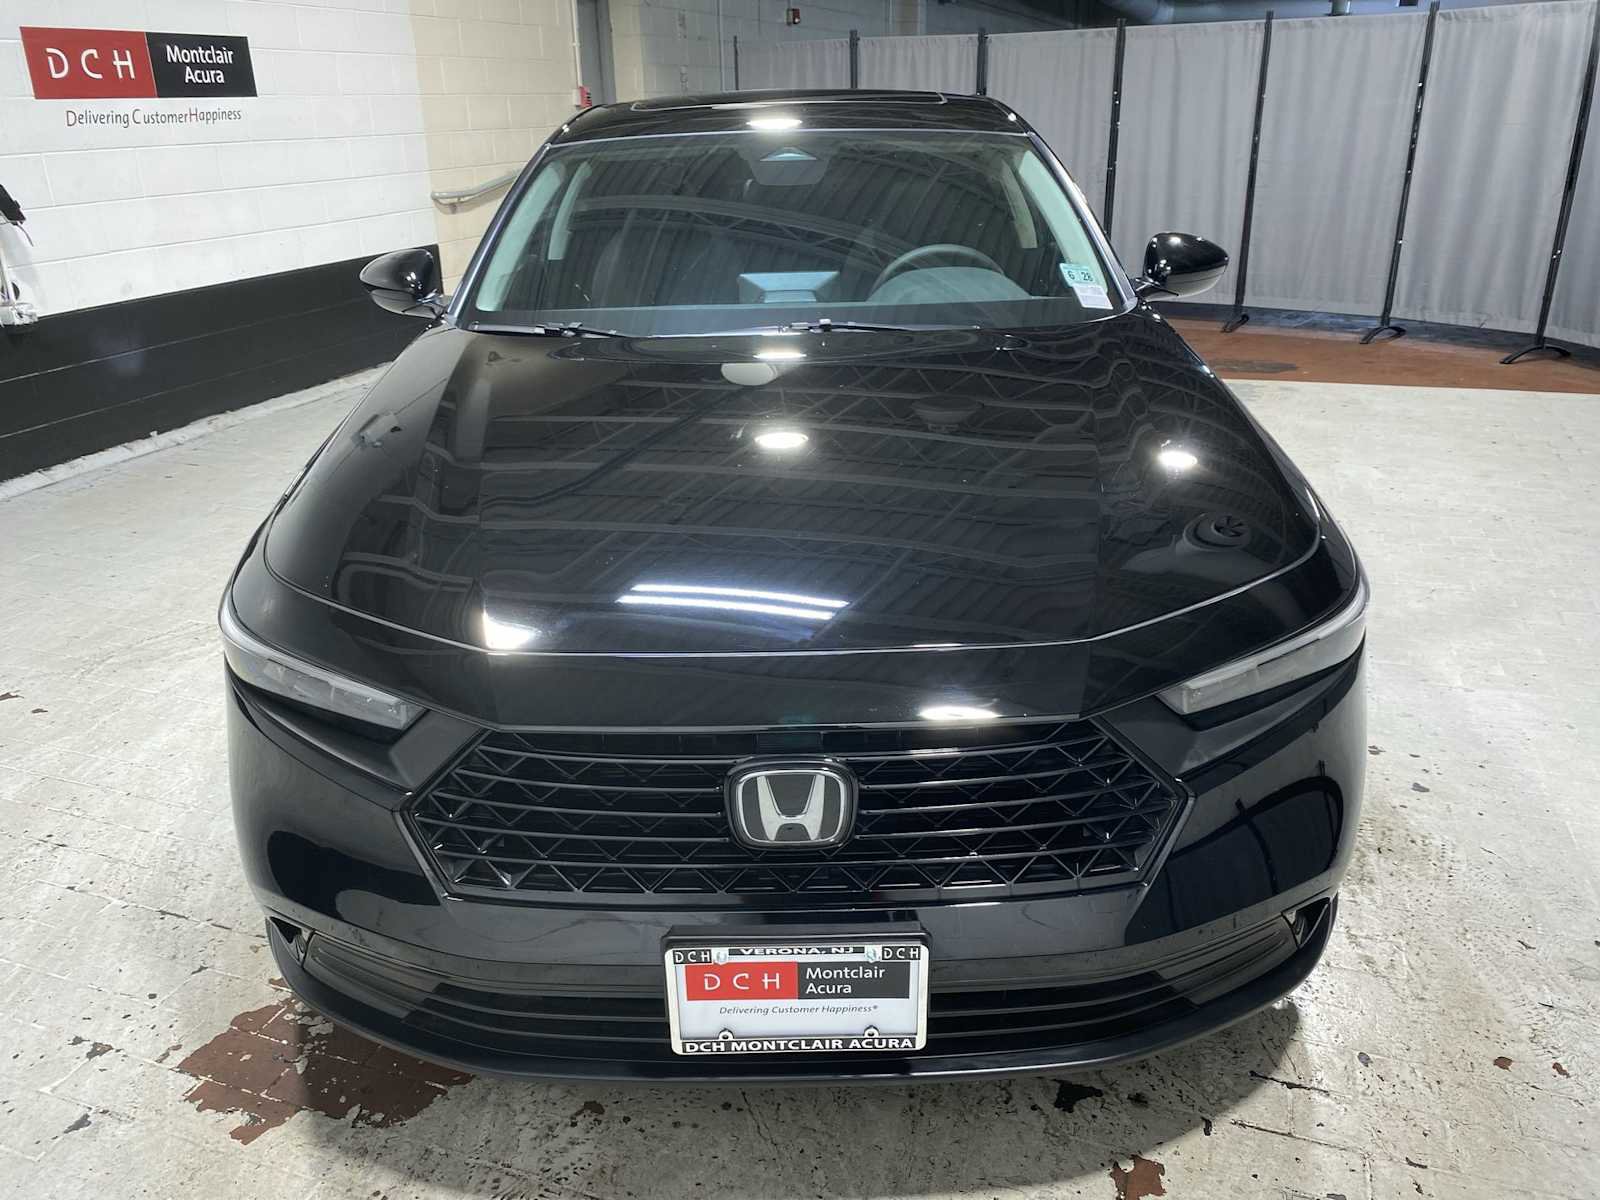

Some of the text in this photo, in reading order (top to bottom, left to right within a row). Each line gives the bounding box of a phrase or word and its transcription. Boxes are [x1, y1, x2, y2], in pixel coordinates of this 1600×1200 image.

[166, 45, 234, 65] Montclair
[45, 48, 136, 79] DCH
[184, 66, 225, 84] Acura
[66, 109, 130, 129] Delivering
[674, 951, 711, 963] DCH
[883, 947, 919, 959] DCH
[805, 966, 886, 980] Montclair
[703, 972, 780, 991] DCH
[805, 982, 852, 994] Acura
[719, 1006, 770, 1016] Delivering
[771, 1005, 819, 1014] Customer
[685, 1037, 913, 1052] DCH MONTCLAIR ACURA
